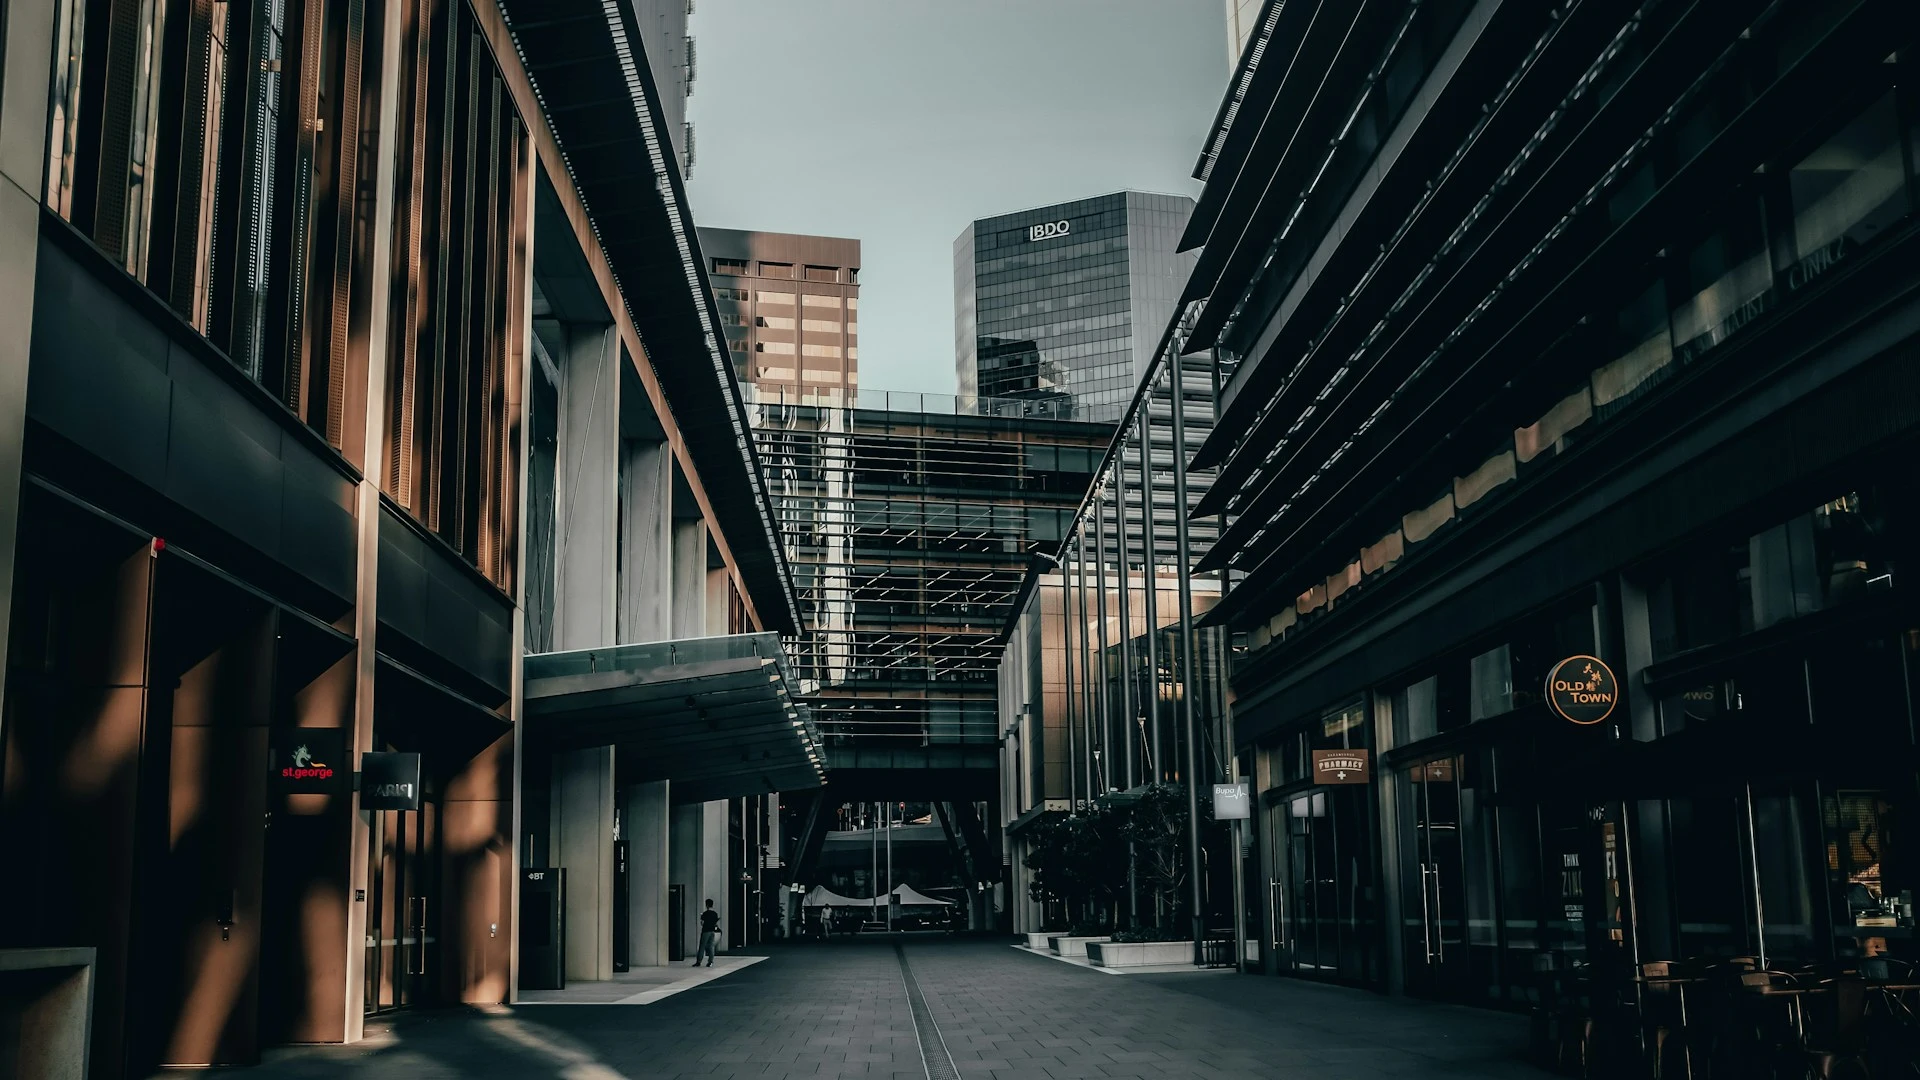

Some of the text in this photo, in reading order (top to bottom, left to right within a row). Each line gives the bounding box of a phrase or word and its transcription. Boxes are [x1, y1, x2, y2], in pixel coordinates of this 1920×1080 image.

[1555, 680, 1584, 691] OLD
[1570, 692, 1611, 703] TOWN
[1319, 760, 1364, 770] PHARMACY
[282, 767, 333, 779] st.george
[1216, 787, 1235, 795] Bupa
[533, 872, 544, 881] BT
